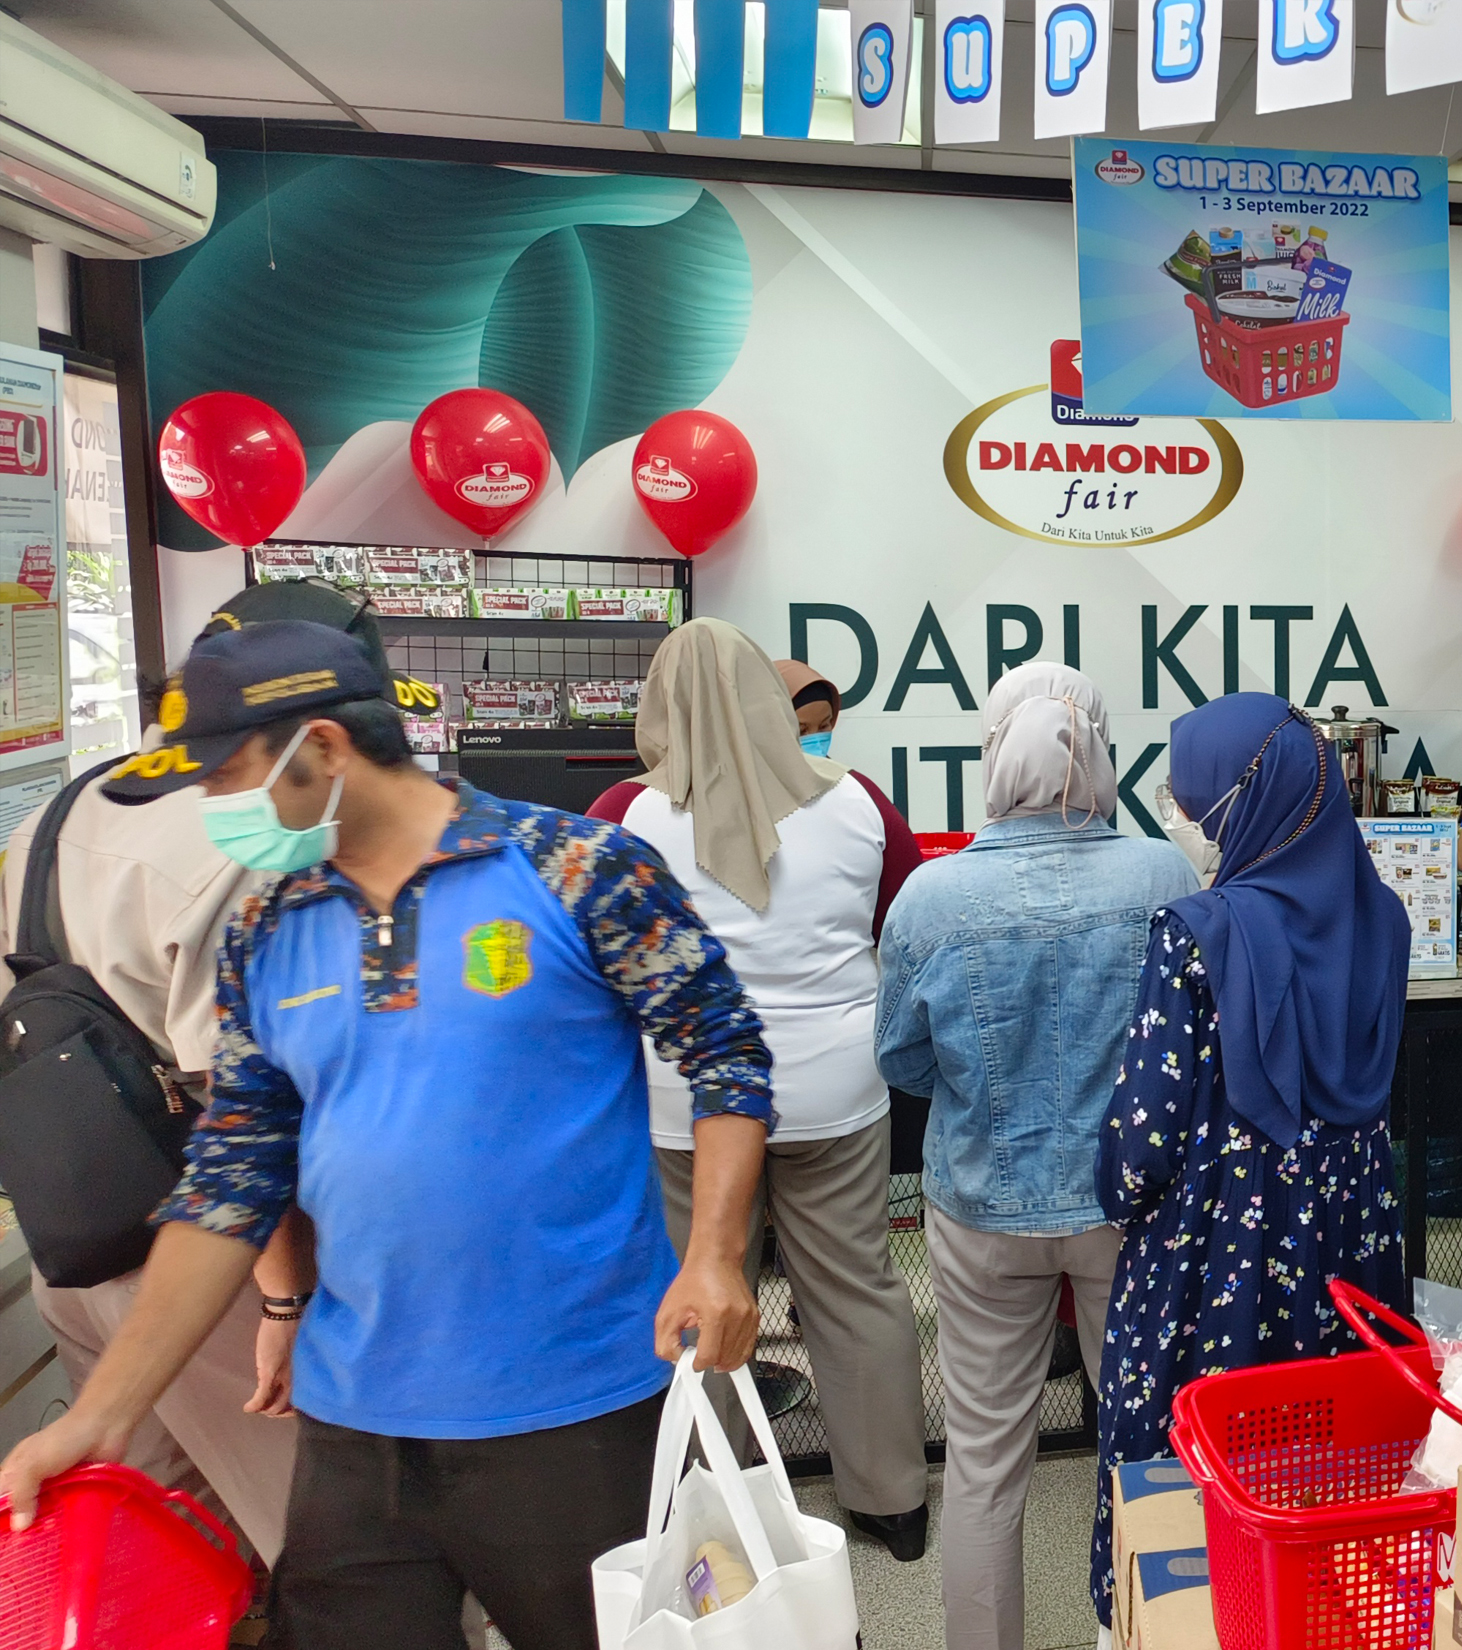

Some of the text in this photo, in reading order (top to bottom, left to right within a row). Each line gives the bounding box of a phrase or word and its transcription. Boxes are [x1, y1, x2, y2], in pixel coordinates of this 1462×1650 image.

[1100, 166, 1139, 174] DIAMOND
[1154, 155, 1421, 200] SUPER BAZAAR
[1200, 196, 1207, 209] 1
[1223, 197, 1232, 210] 3
[1237, 197, 1326, 215] September
[1329, 202, 1369, 216] 2022
[1313, 267, 1347, 285] Diamond
[1297, 292, 1340, 320] Milk
[979, 441, 1210, 475] DIAMOND
[464, 482, 527, 493] DIAMOND
[637, 473, 688, 489] DIAMOND
[650, 484, 669, 494] fair
[486, 492, 511, 501] fair
[1056, 478, 1139, 519] fair
[1041, 522, 1154, 542] Dari Kita Untuk Kita
[789, 601, 1389, 711] DARI KITA
[463, 735, 502, 744] Lenovo
